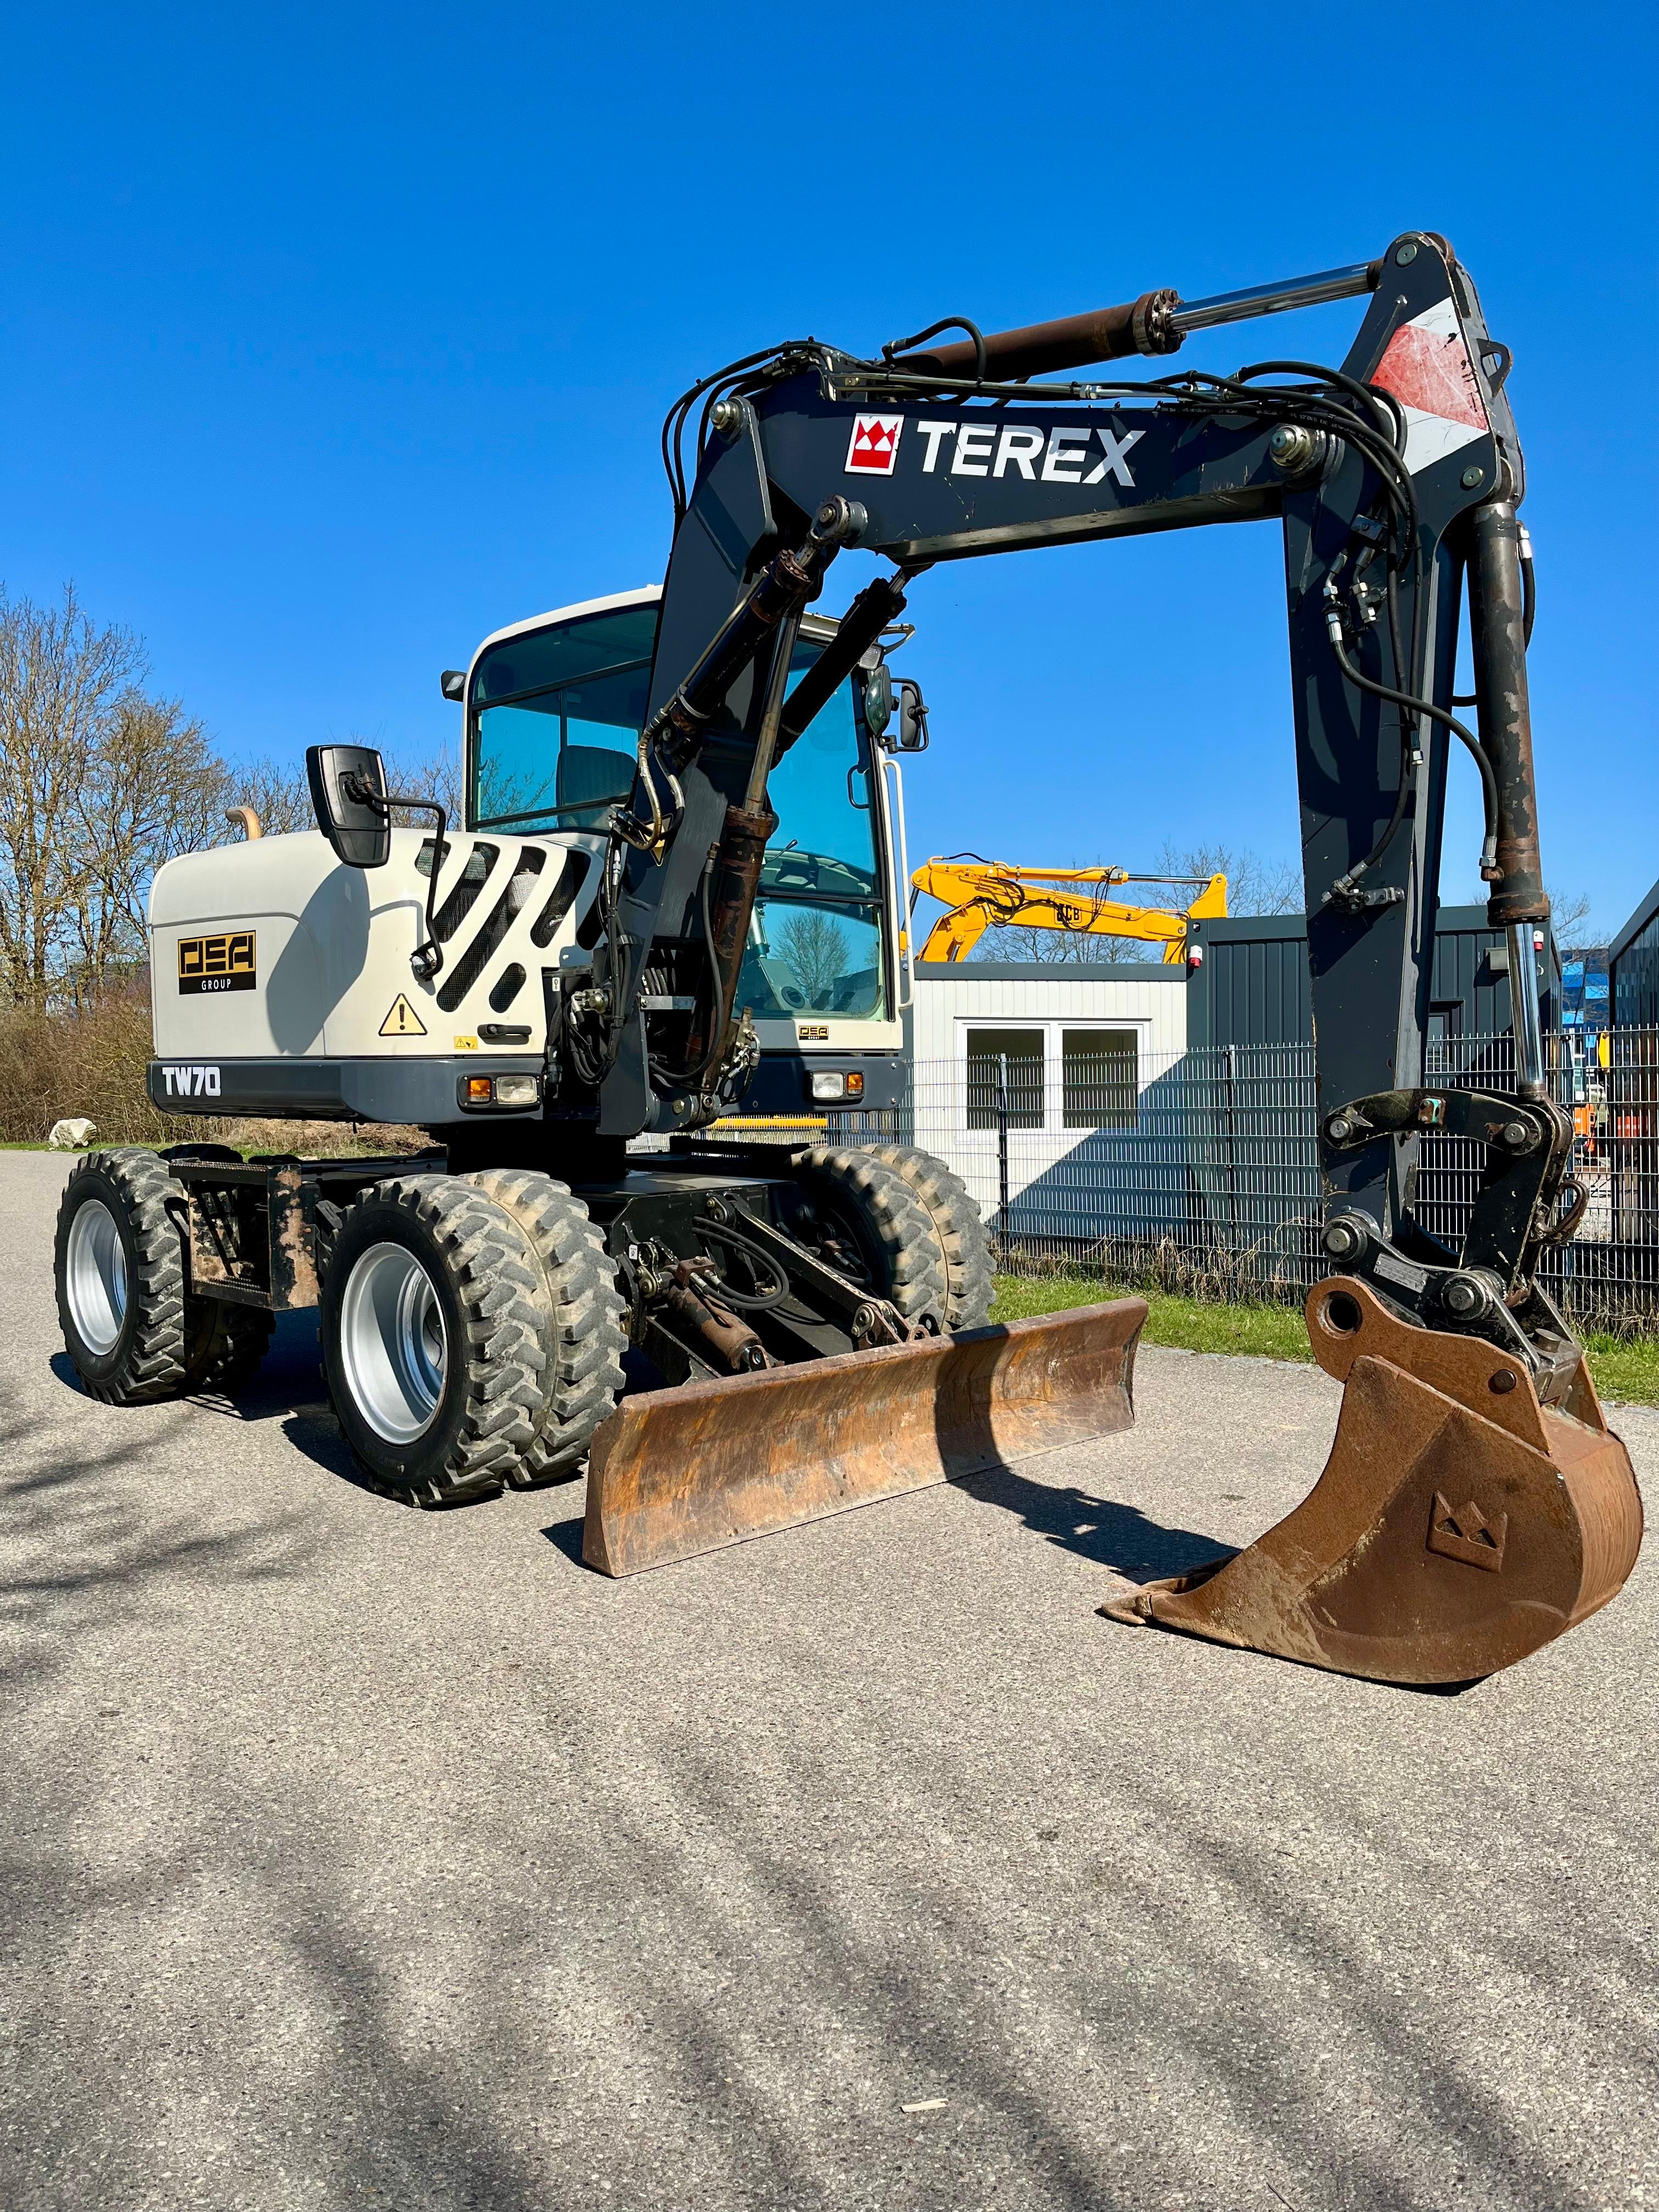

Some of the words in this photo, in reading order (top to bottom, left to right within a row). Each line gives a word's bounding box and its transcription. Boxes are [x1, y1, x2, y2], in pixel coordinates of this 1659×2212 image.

[917, 420, 1146, 487] TEREX
[201, 978, 232, 990] GROUP
[162, 1066, 221, 1096] TW70
